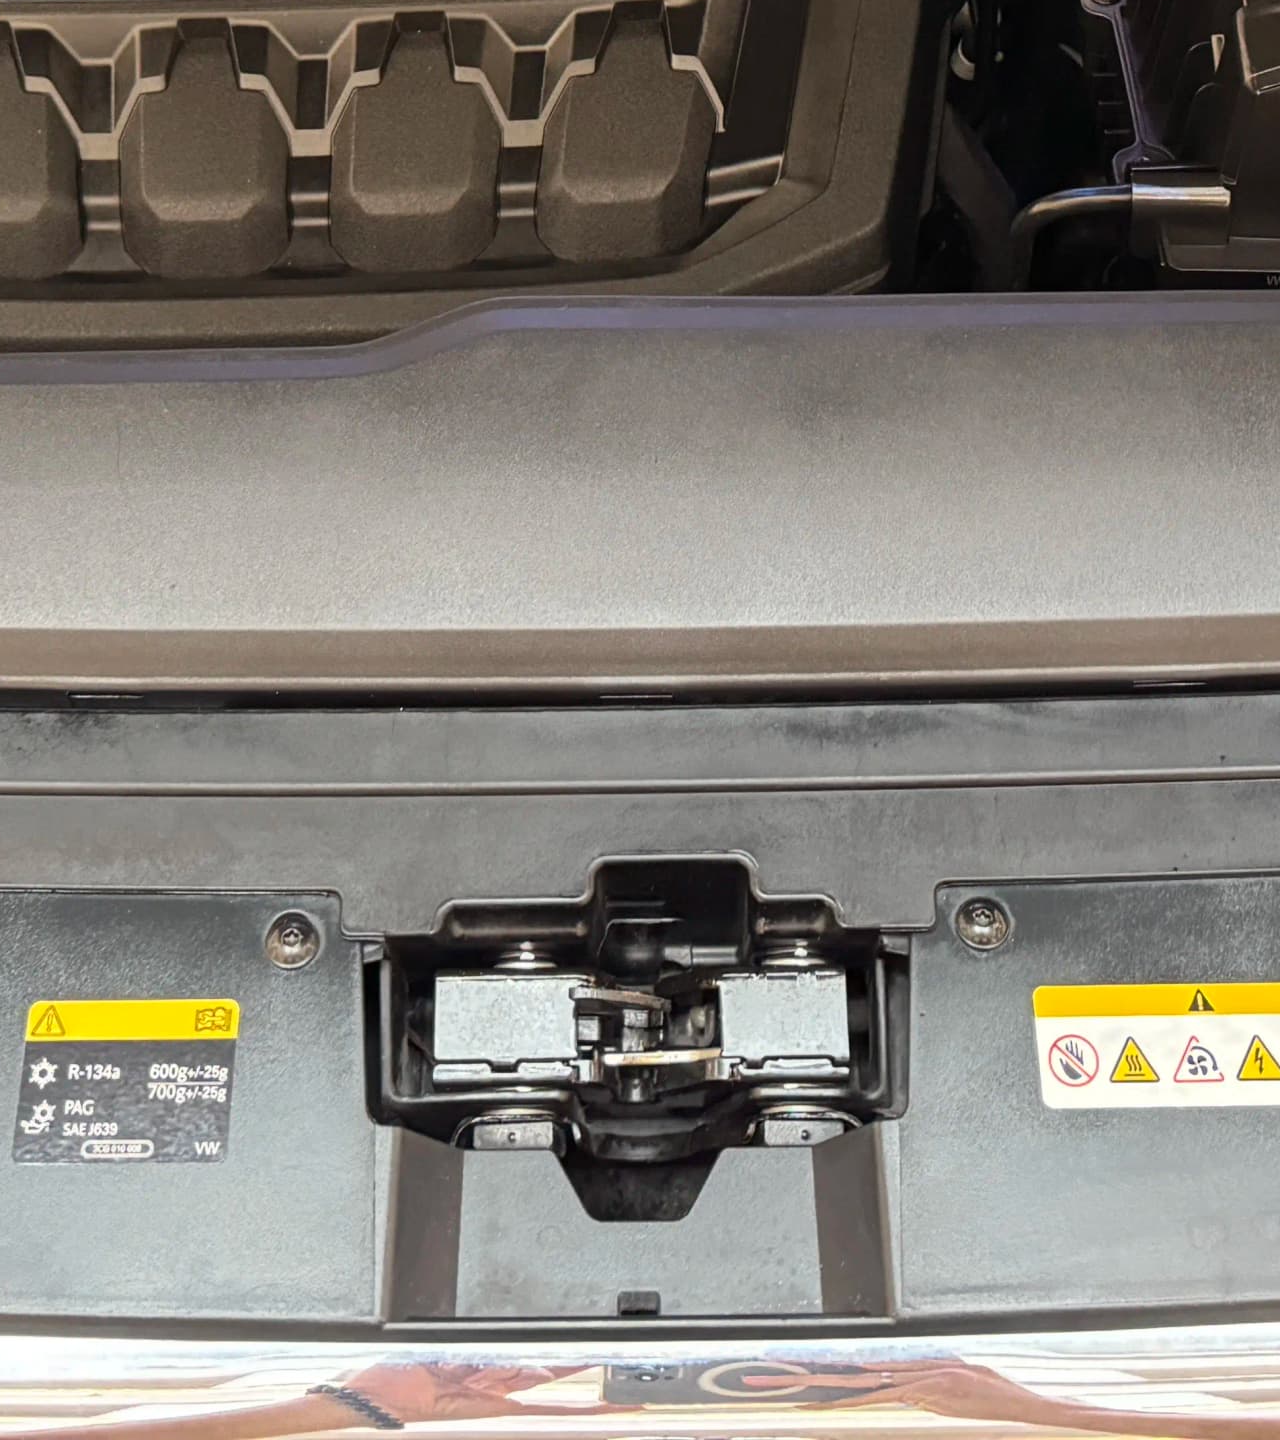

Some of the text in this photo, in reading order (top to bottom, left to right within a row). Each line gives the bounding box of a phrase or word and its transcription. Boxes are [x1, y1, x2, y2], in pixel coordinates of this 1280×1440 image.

[67, 1063, 121, 1081] R-134a
[149, 1063, 229, 1083] 600g+/-25g
[148, 1083, 228, 1104] 700g+/-25g
[63, 1099, 95, 1116] PAG
[62, 1122, 119, 1137] SAE J639
[194, 1141, 221, 1156] VW
